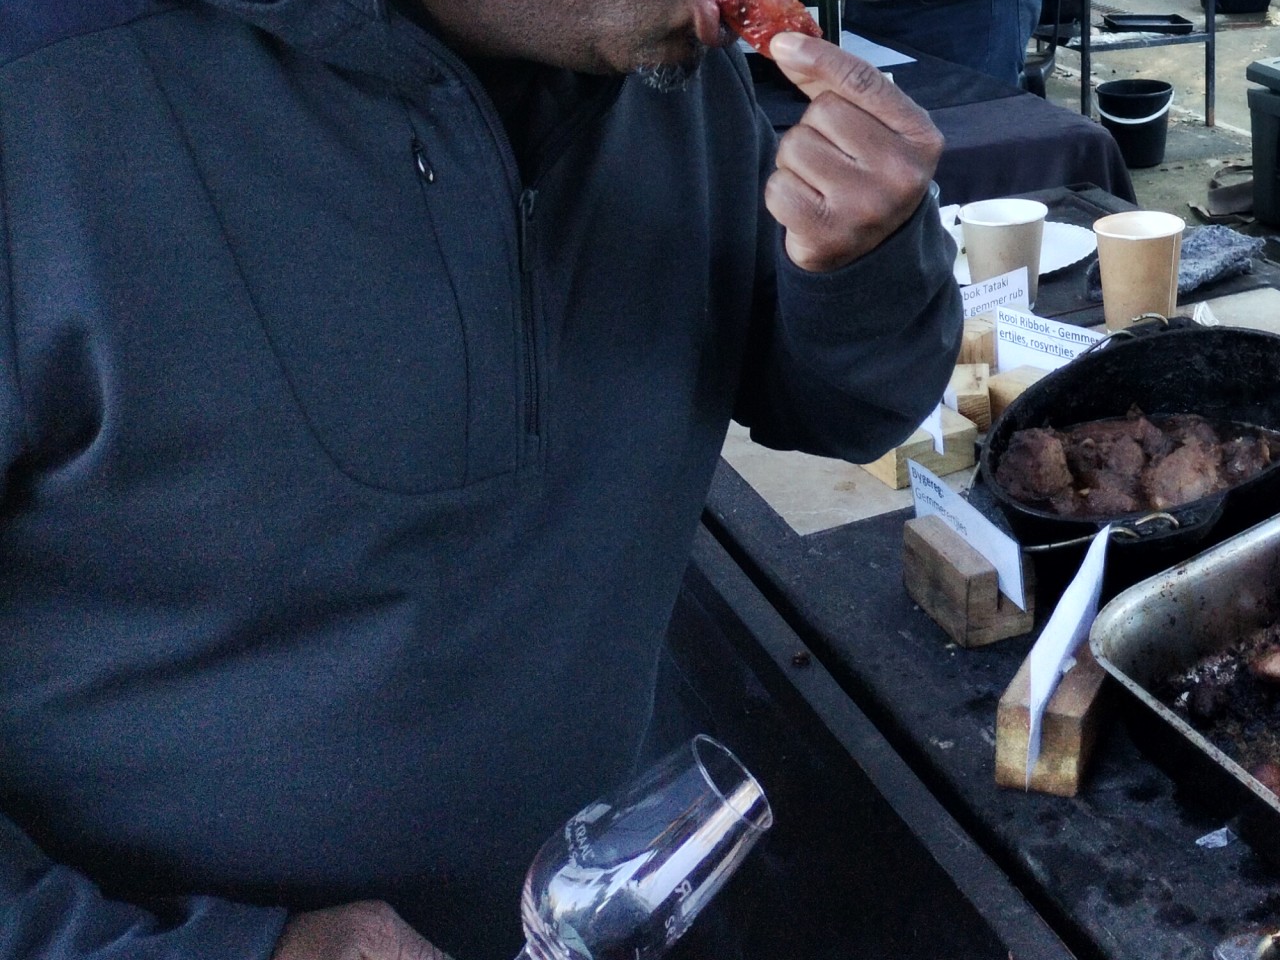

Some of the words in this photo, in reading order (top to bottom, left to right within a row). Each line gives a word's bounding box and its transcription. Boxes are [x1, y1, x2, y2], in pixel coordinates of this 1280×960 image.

[983, 276, 1009, 293] Tataki
[970, 295, 1006, 317] gemmer
[1010, 288, 1024, 301] rub
[998, 311, 1018, 325] Rooi
[1020, 316, 1050, 334] Ribbok
[1031, 338, 1075, 358] rosyntjies
